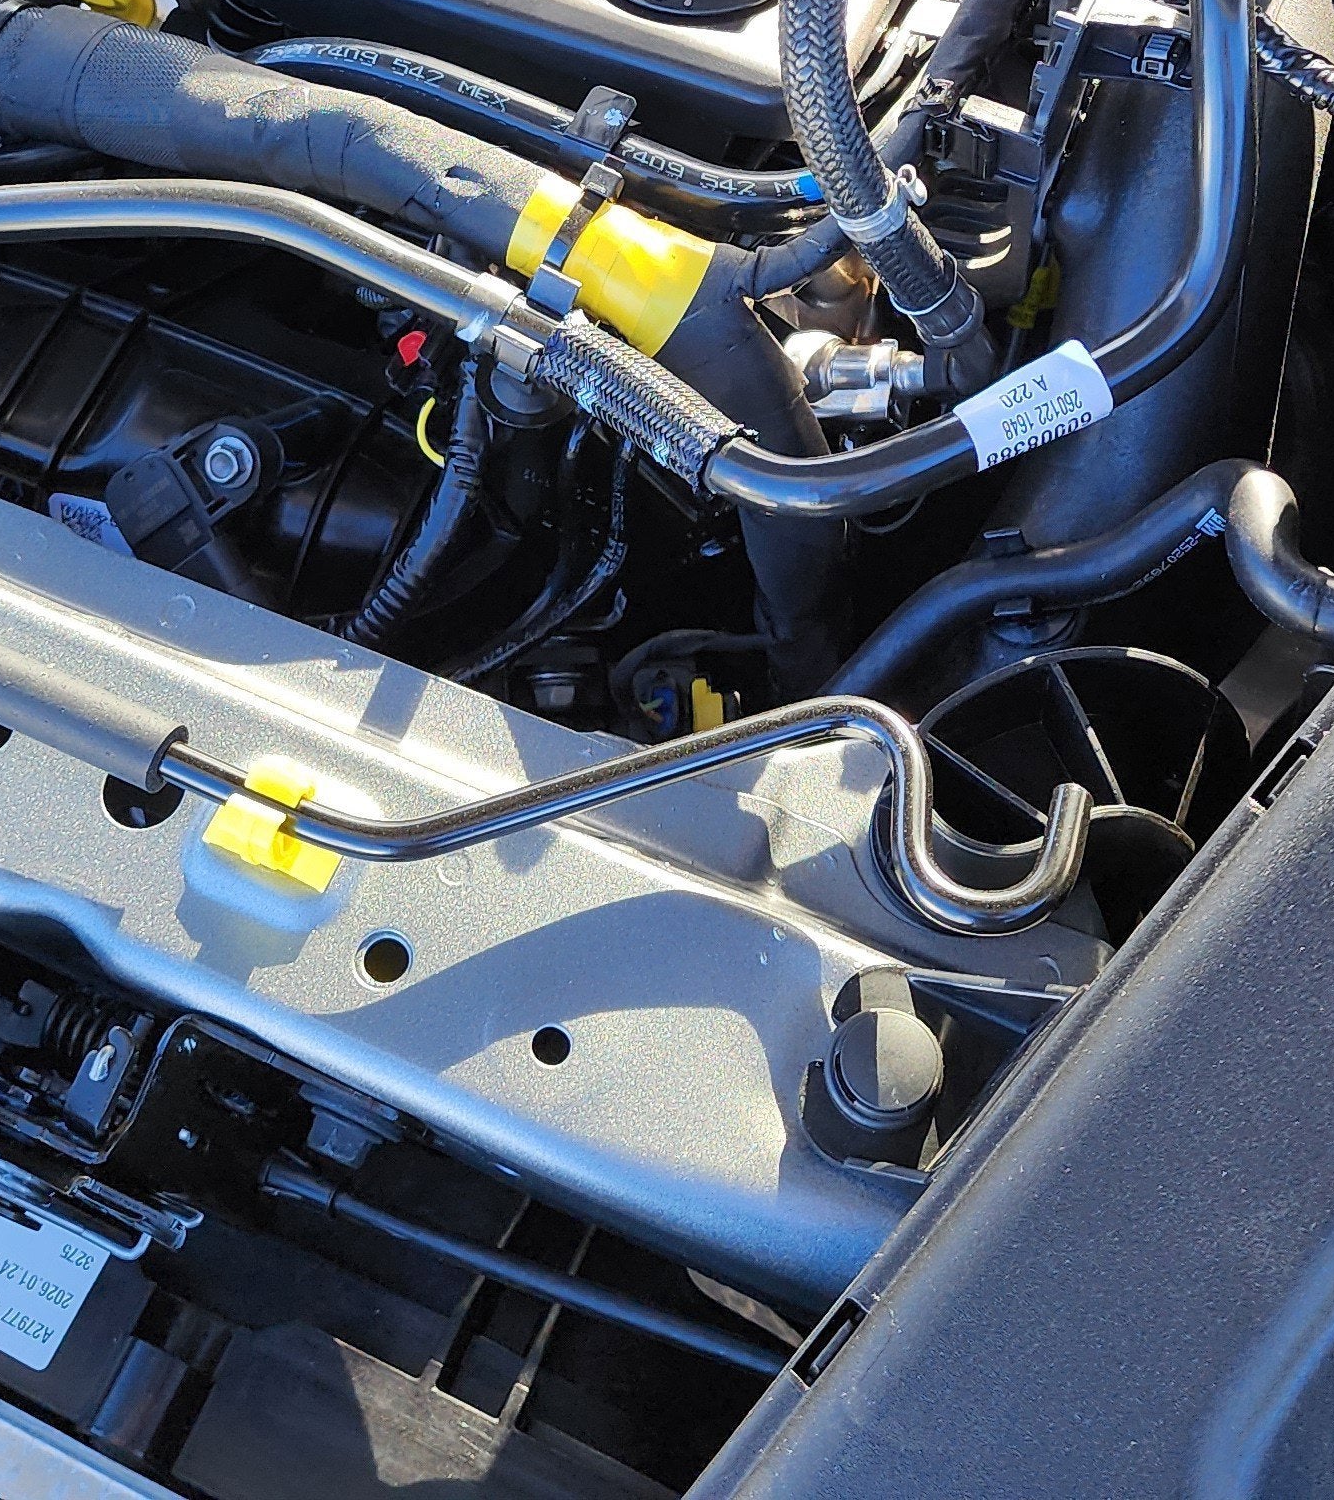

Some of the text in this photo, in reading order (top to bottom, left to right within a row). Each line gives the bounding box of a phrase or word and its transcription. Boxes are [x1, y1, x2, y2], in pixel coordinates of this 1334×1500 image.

[391, 55, 446, 89] 542
[457, 79, 513, 114] MEX
[699, 171, 758, 198] 542
[998, 373, 1049, 409] A 220
[1001, 388, 1084, 442] 260122 1648
[58, 1242, 96, 1271] 3275
[0, 1306, 55, 1345] A27977
